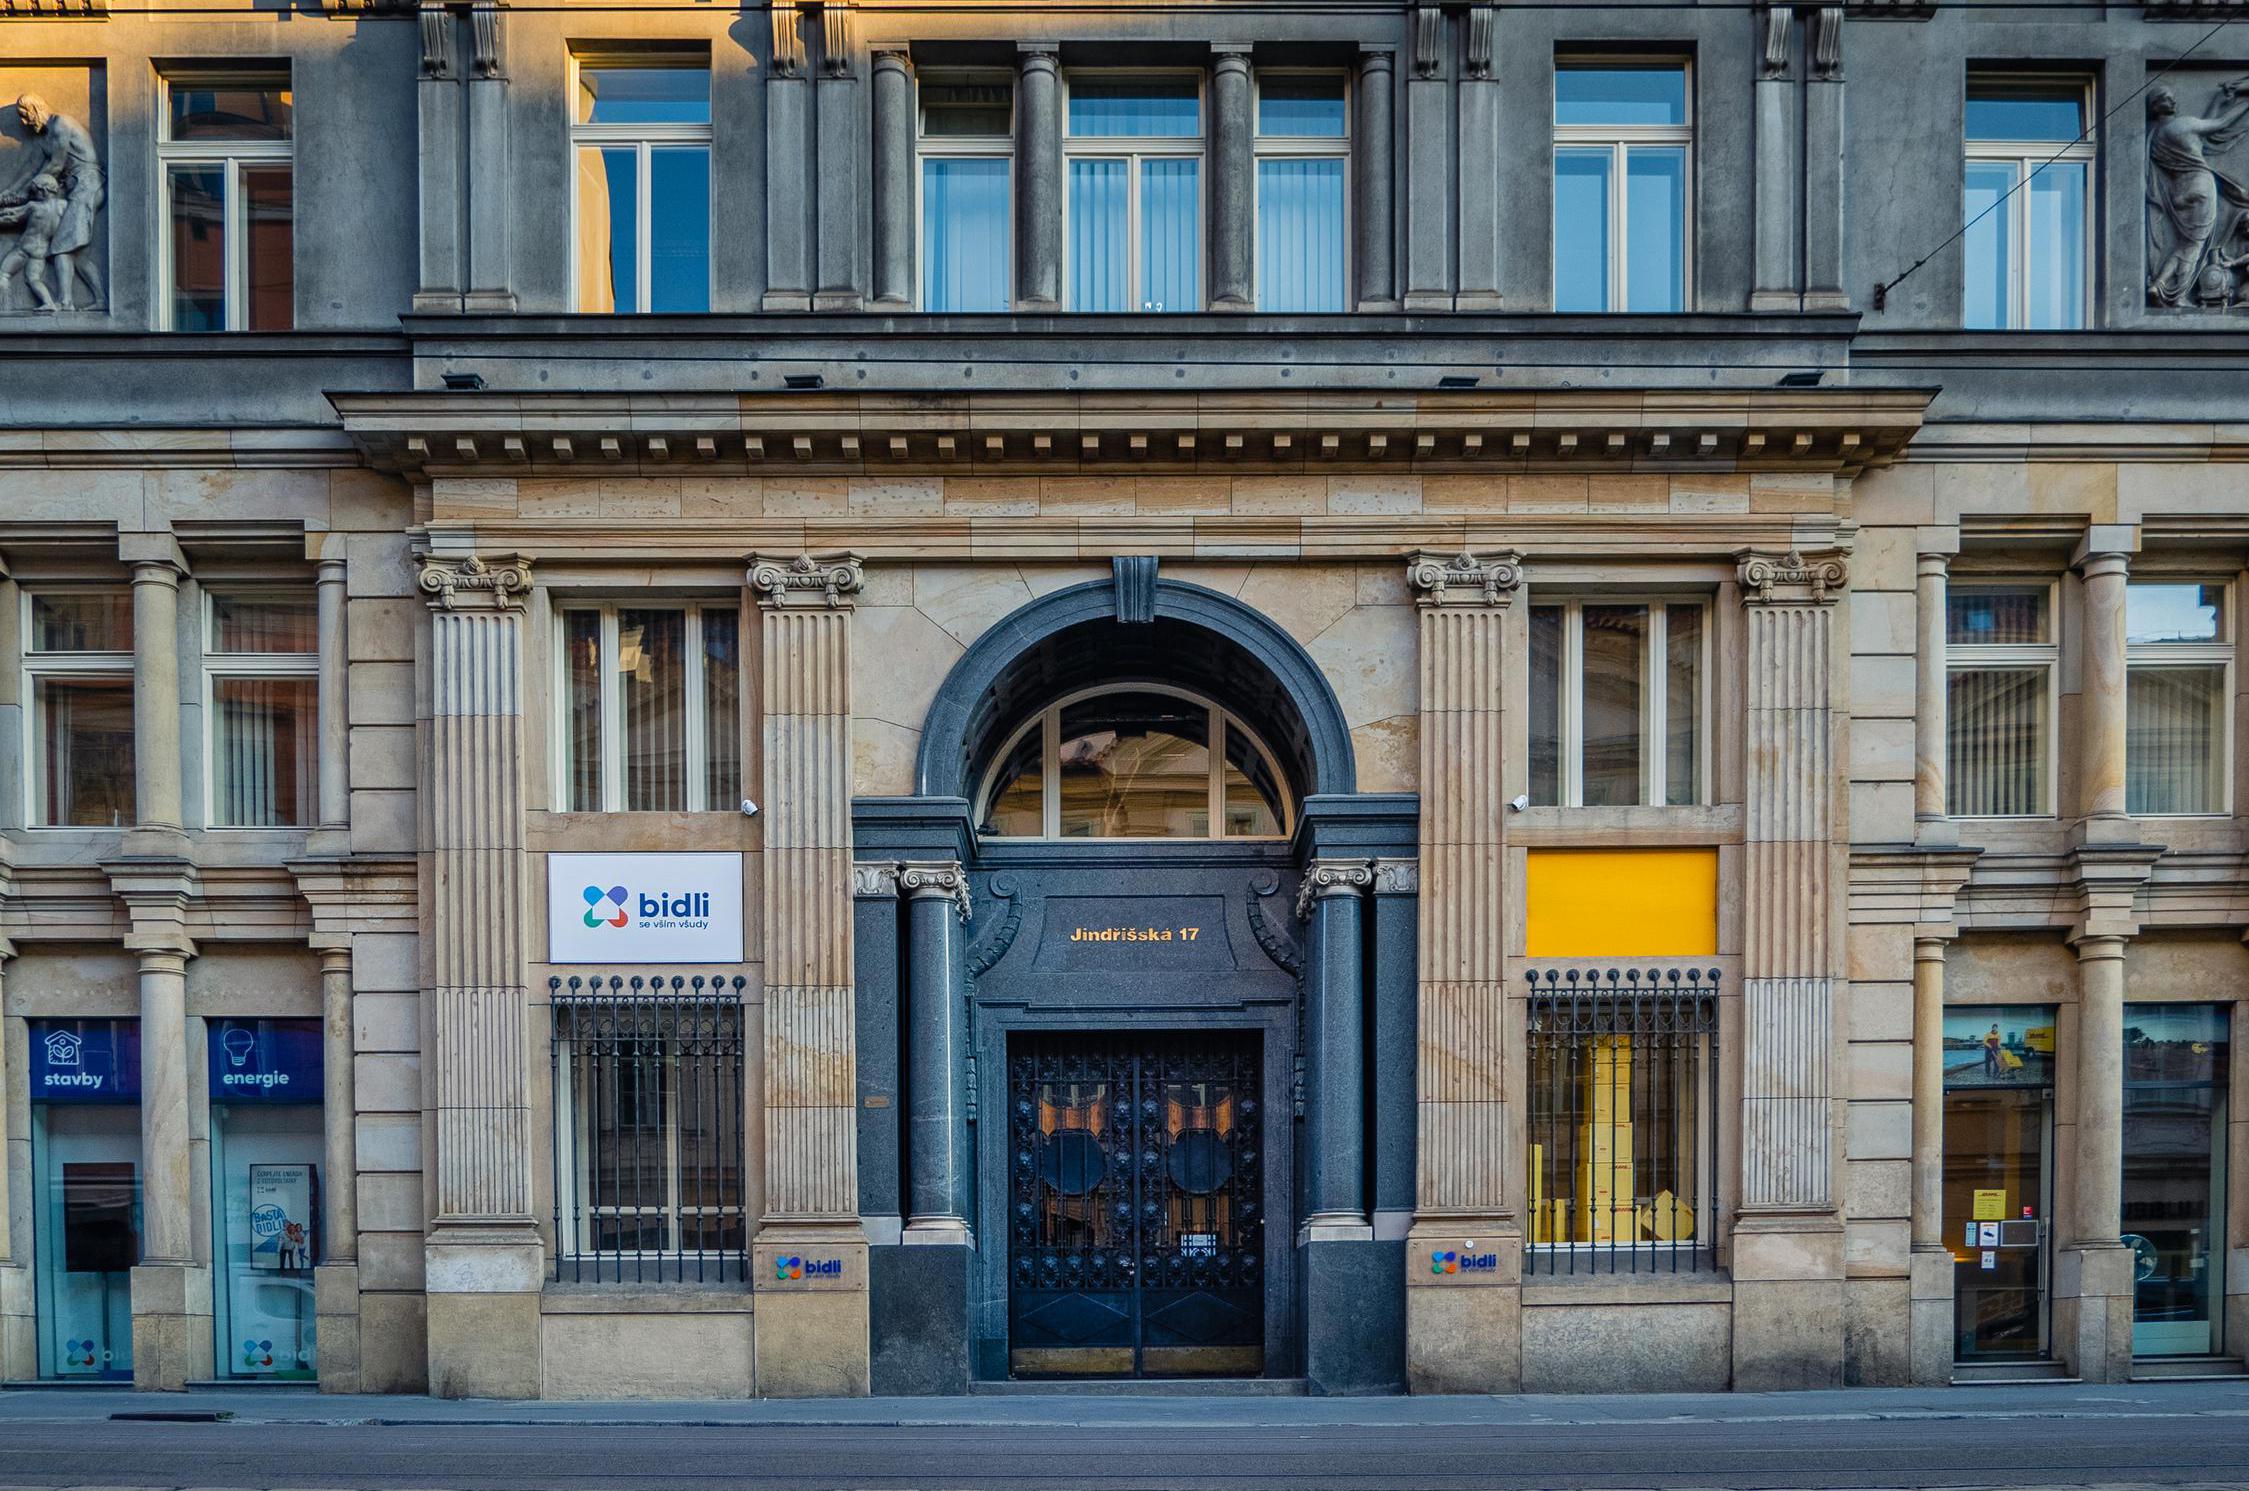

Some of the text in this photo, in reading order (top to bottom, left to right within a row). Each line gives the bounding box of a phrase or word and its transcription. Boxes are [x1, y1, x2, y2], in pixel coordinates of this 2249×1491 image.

[640, 892, 709, 917] bidli
[654, 920, 676, 928] vším
[679, 920, 708, 930] všudy
[1070, 927, 1200, 941] Jindřišská 17
[44, 1071, 104, 1090] stavby
[223, 1070, 290, 1089] energie
[805, 1260, 841, 1273] bidli
[1461, 1254, 1496, 1267] bidli
